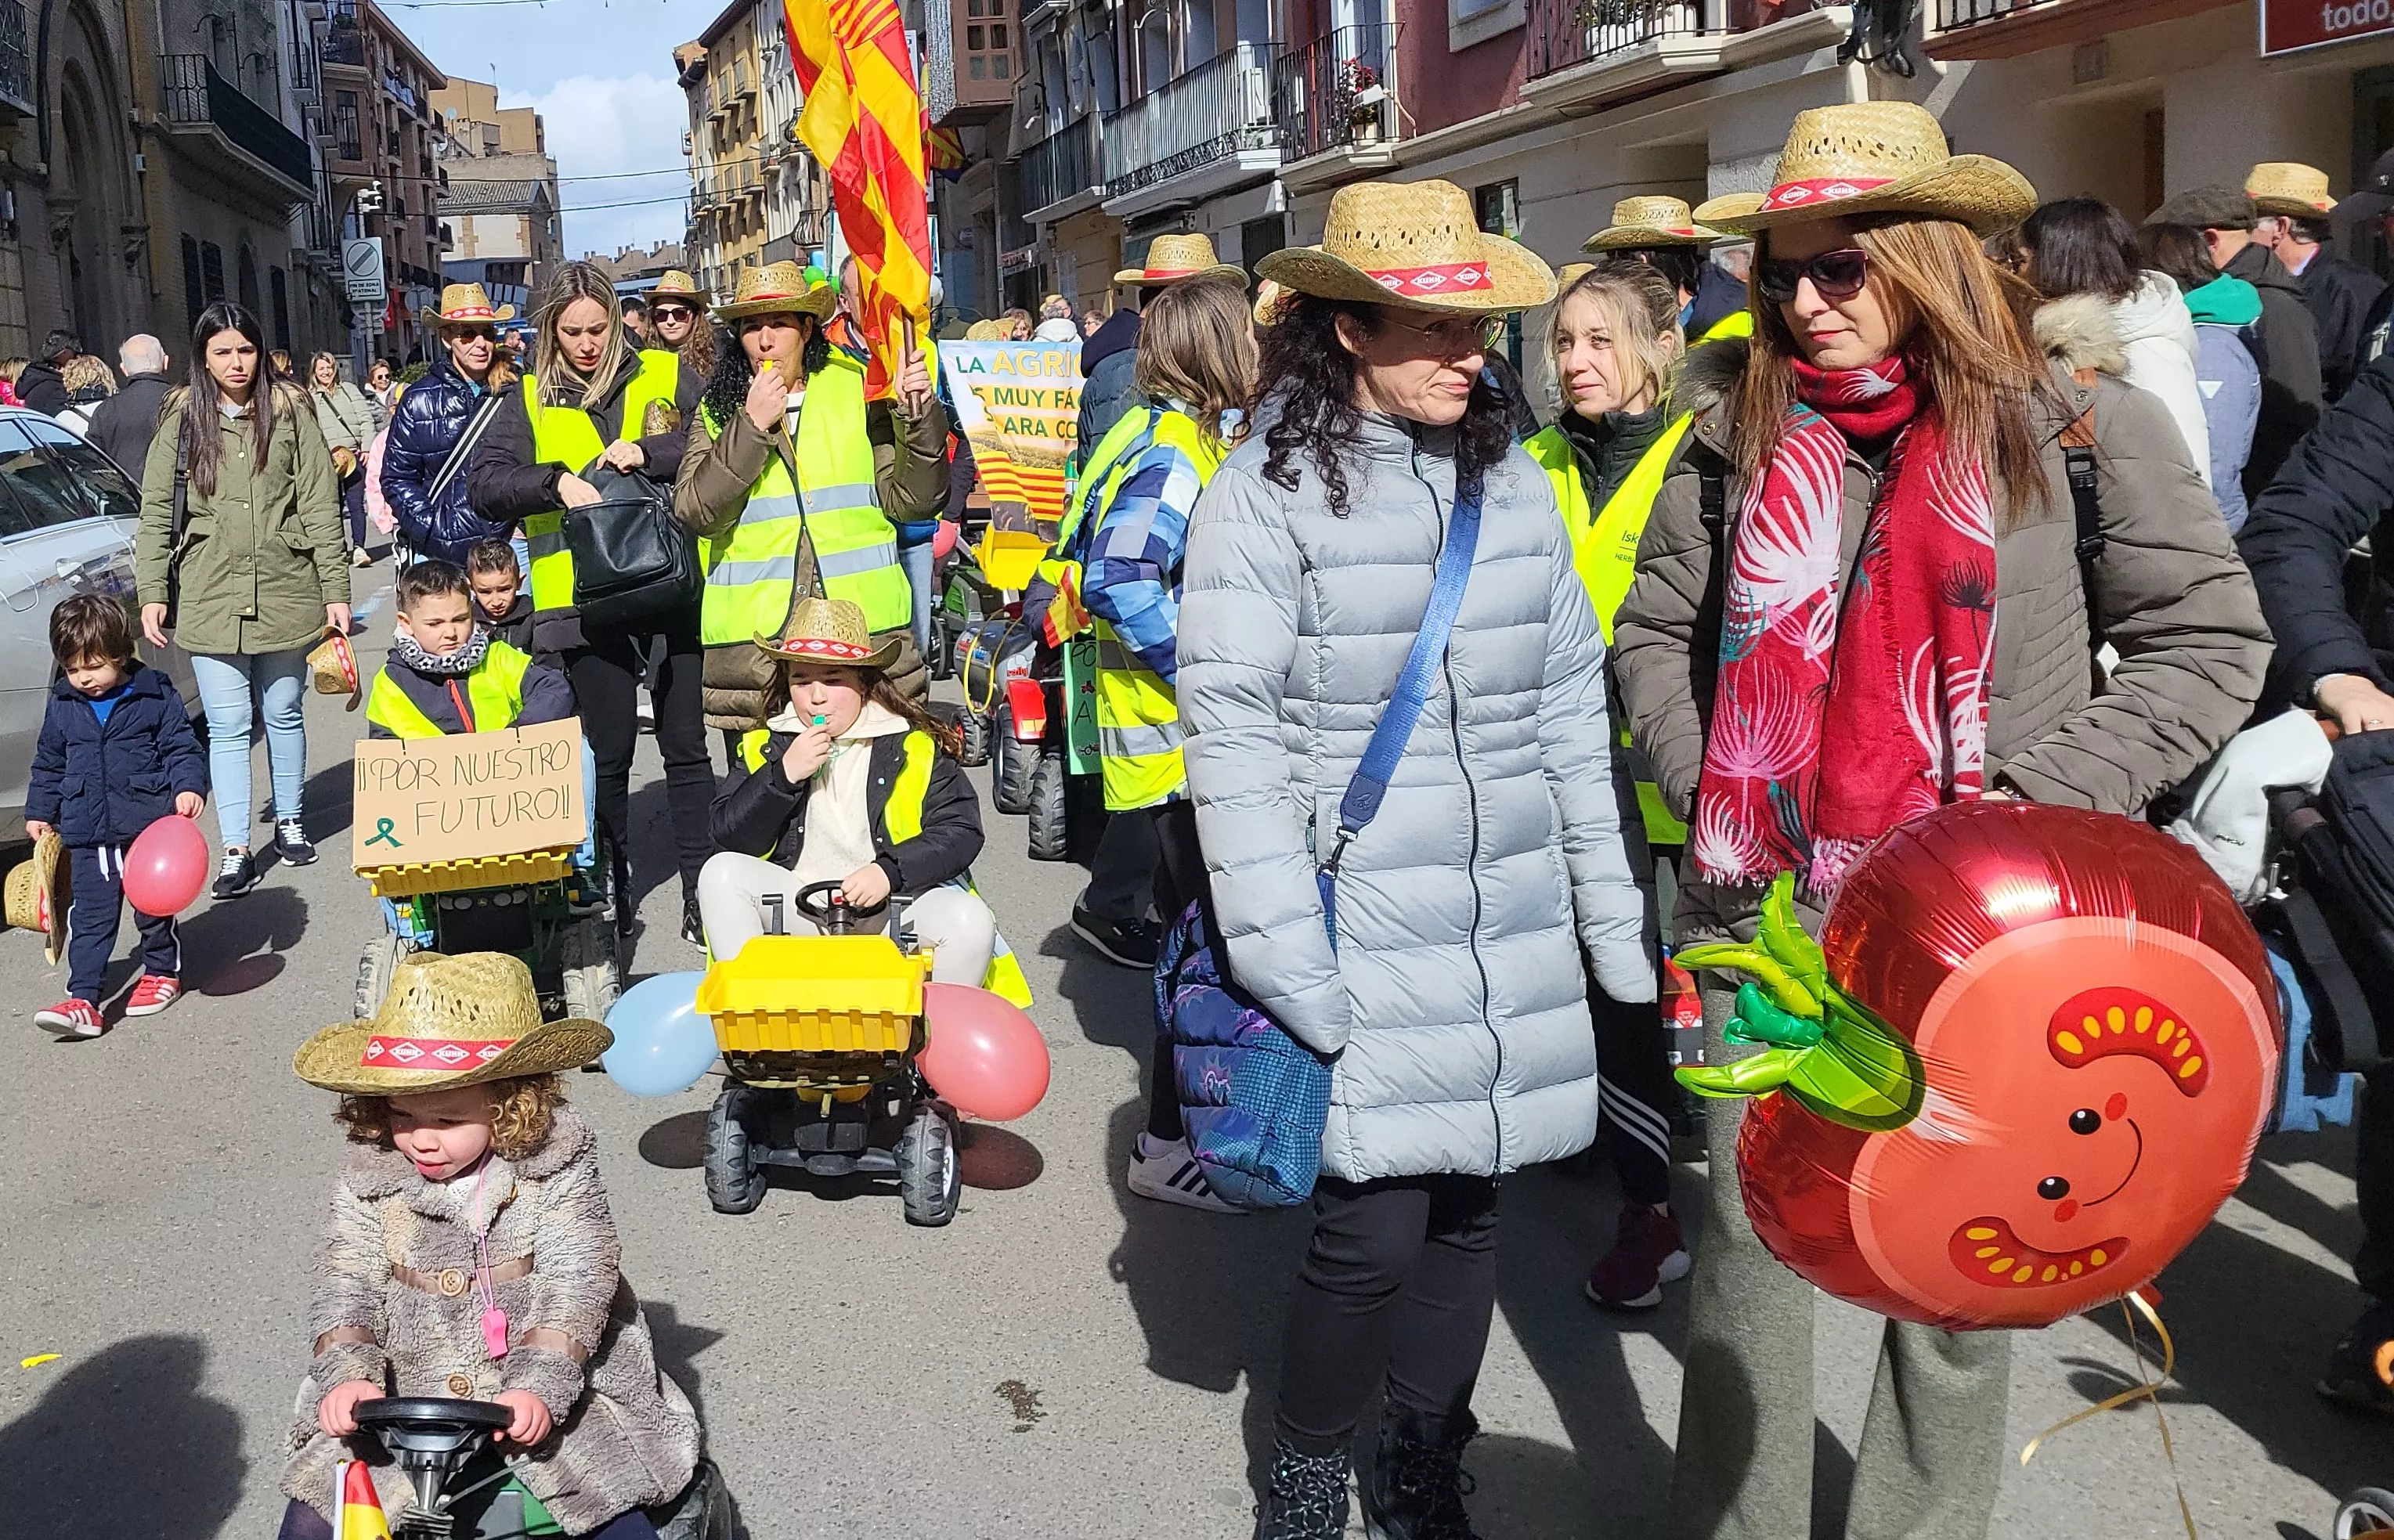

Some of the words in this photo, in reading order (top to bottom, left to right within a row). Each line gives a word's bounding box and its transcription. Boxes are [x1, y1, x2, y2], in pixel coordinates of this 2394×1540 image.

[2321, 0, 2394, 31] todo
[955, 355, 986, 373] LA
[994, 387, 1046, 408] MUY
[1054, 386, 1081, 409] FÁ
[454, 739, 571, 786] NUESTRO
[415, 783, 570, 836] FUTURO!!
